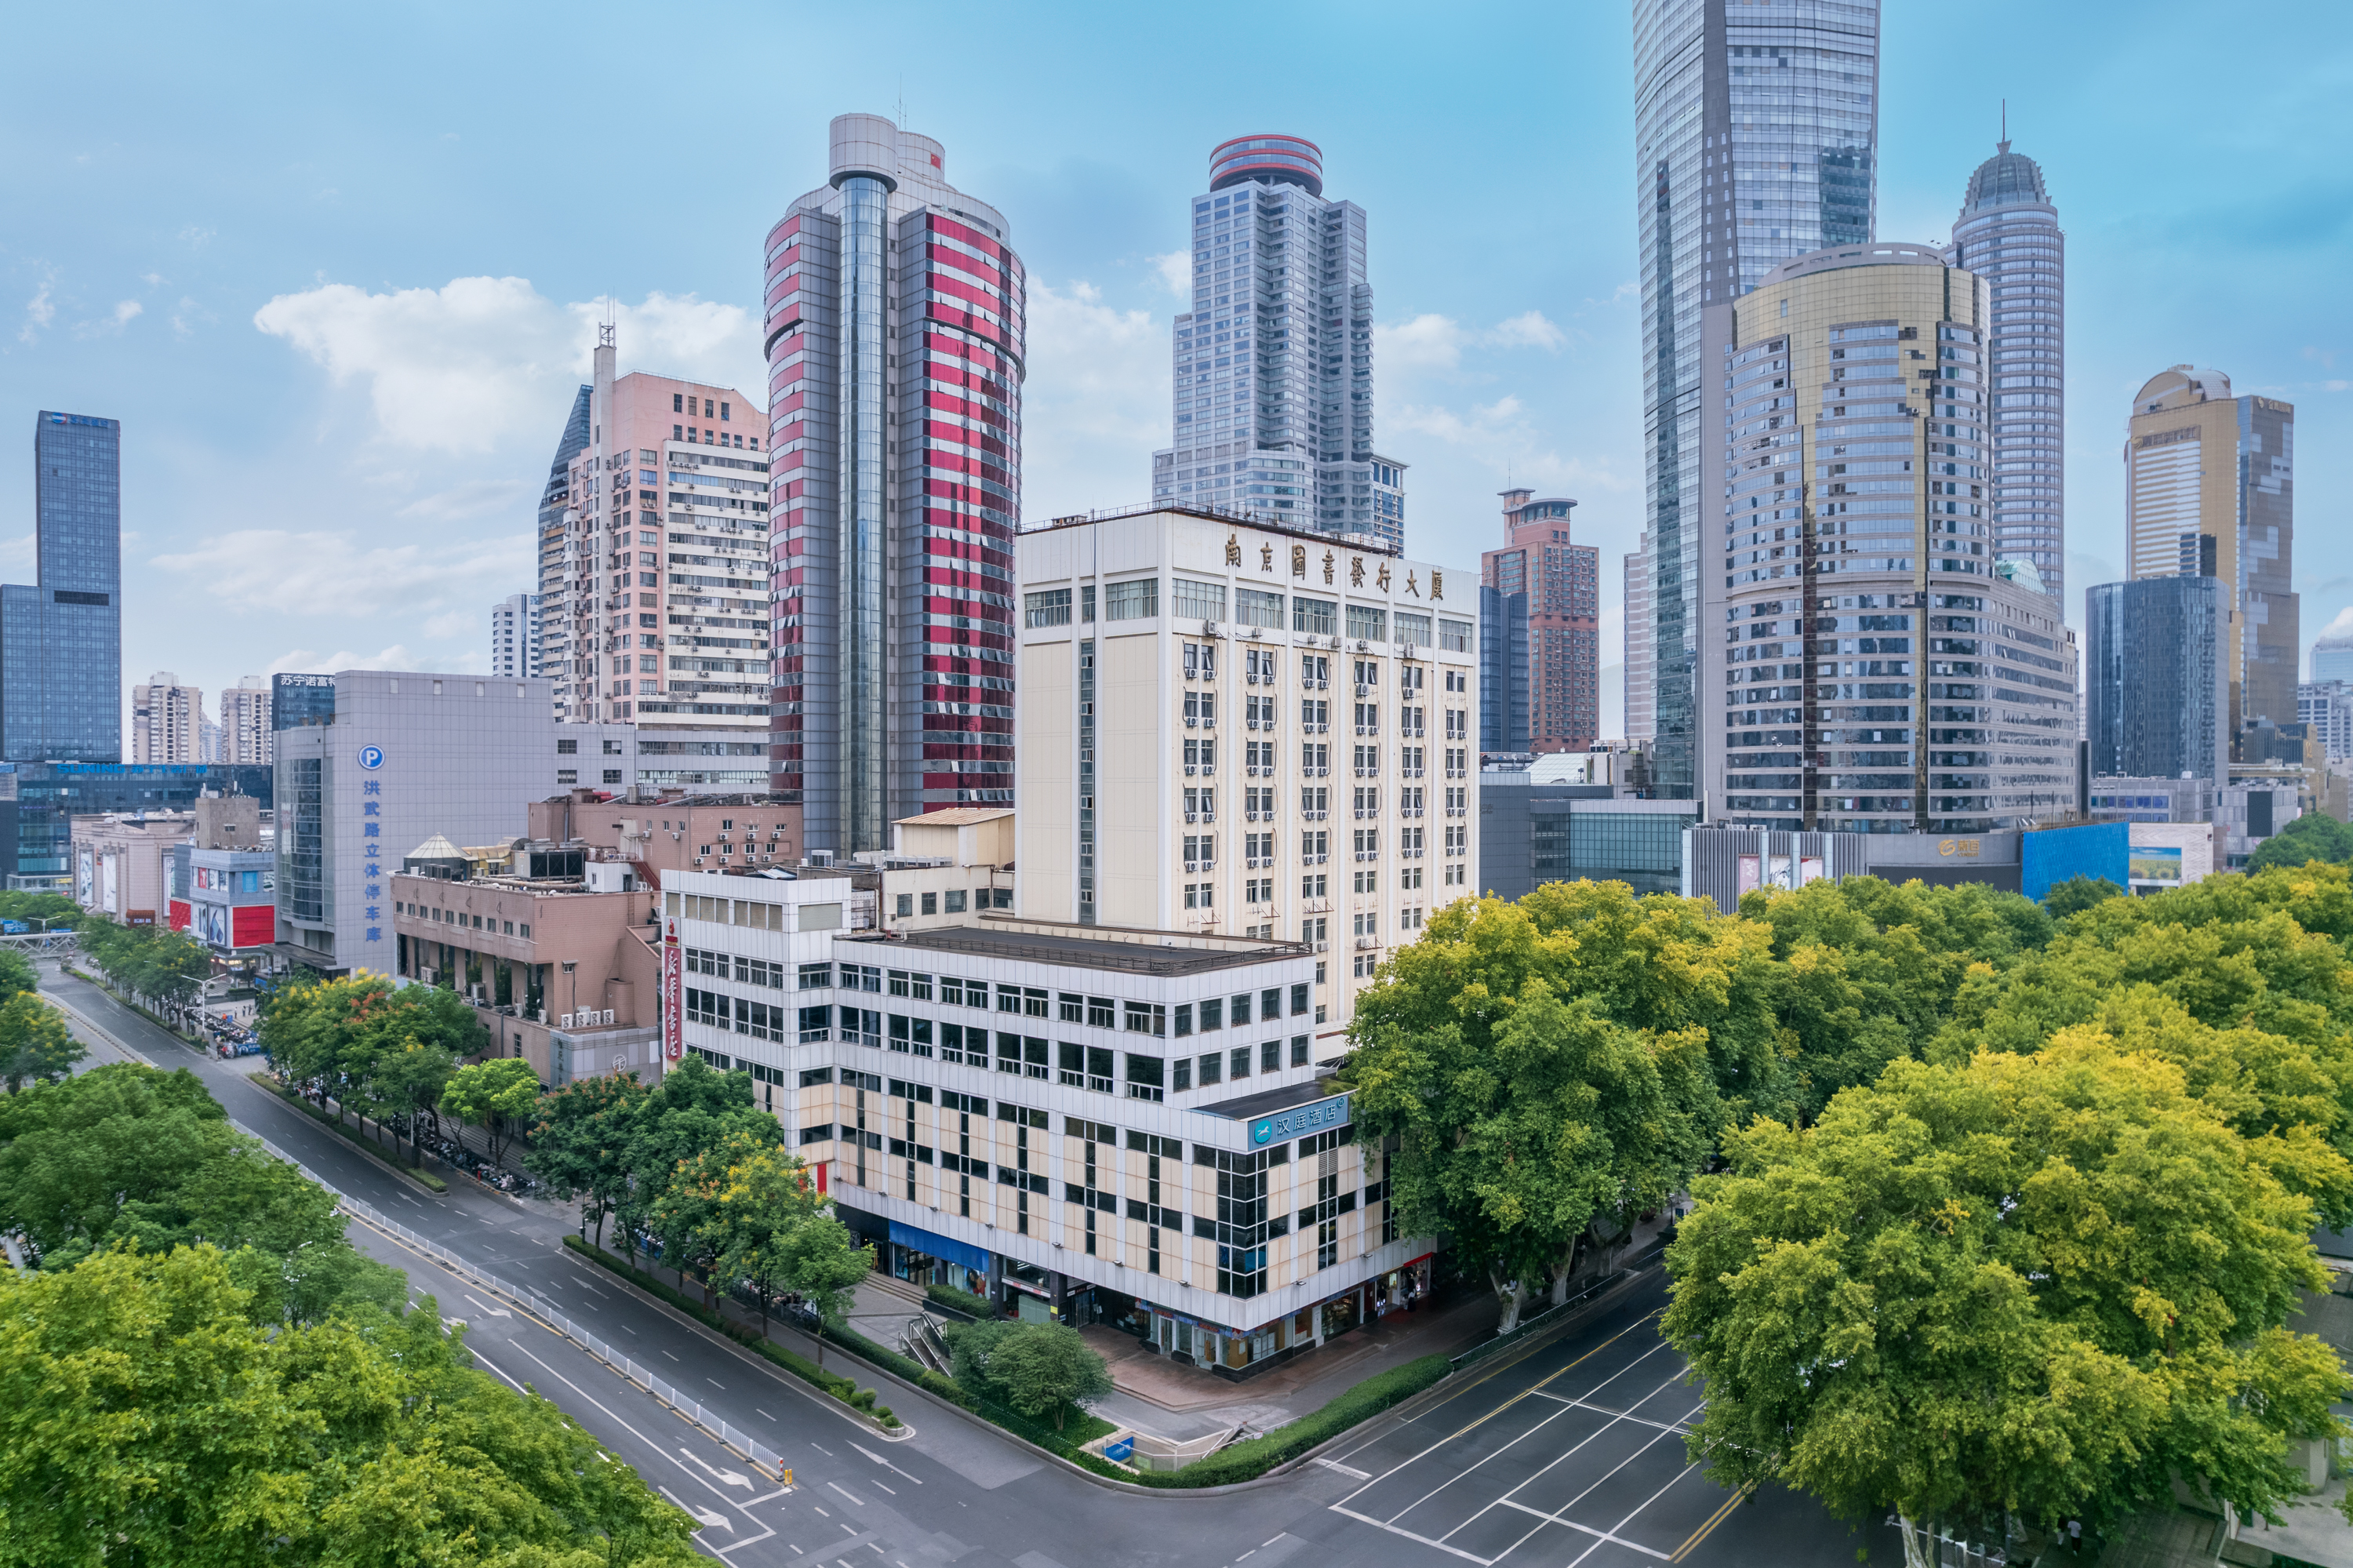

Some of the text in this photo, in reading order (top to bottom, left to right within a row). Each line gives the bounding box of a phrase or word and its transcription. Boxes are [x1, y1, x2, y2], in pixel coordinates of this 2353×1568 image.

[57, 764, 125, 773] SUNING
[364, 780, 382, 942] 洪武路立体停车库
[1277, 1104, 1336, 1135] 汉庭酒店
